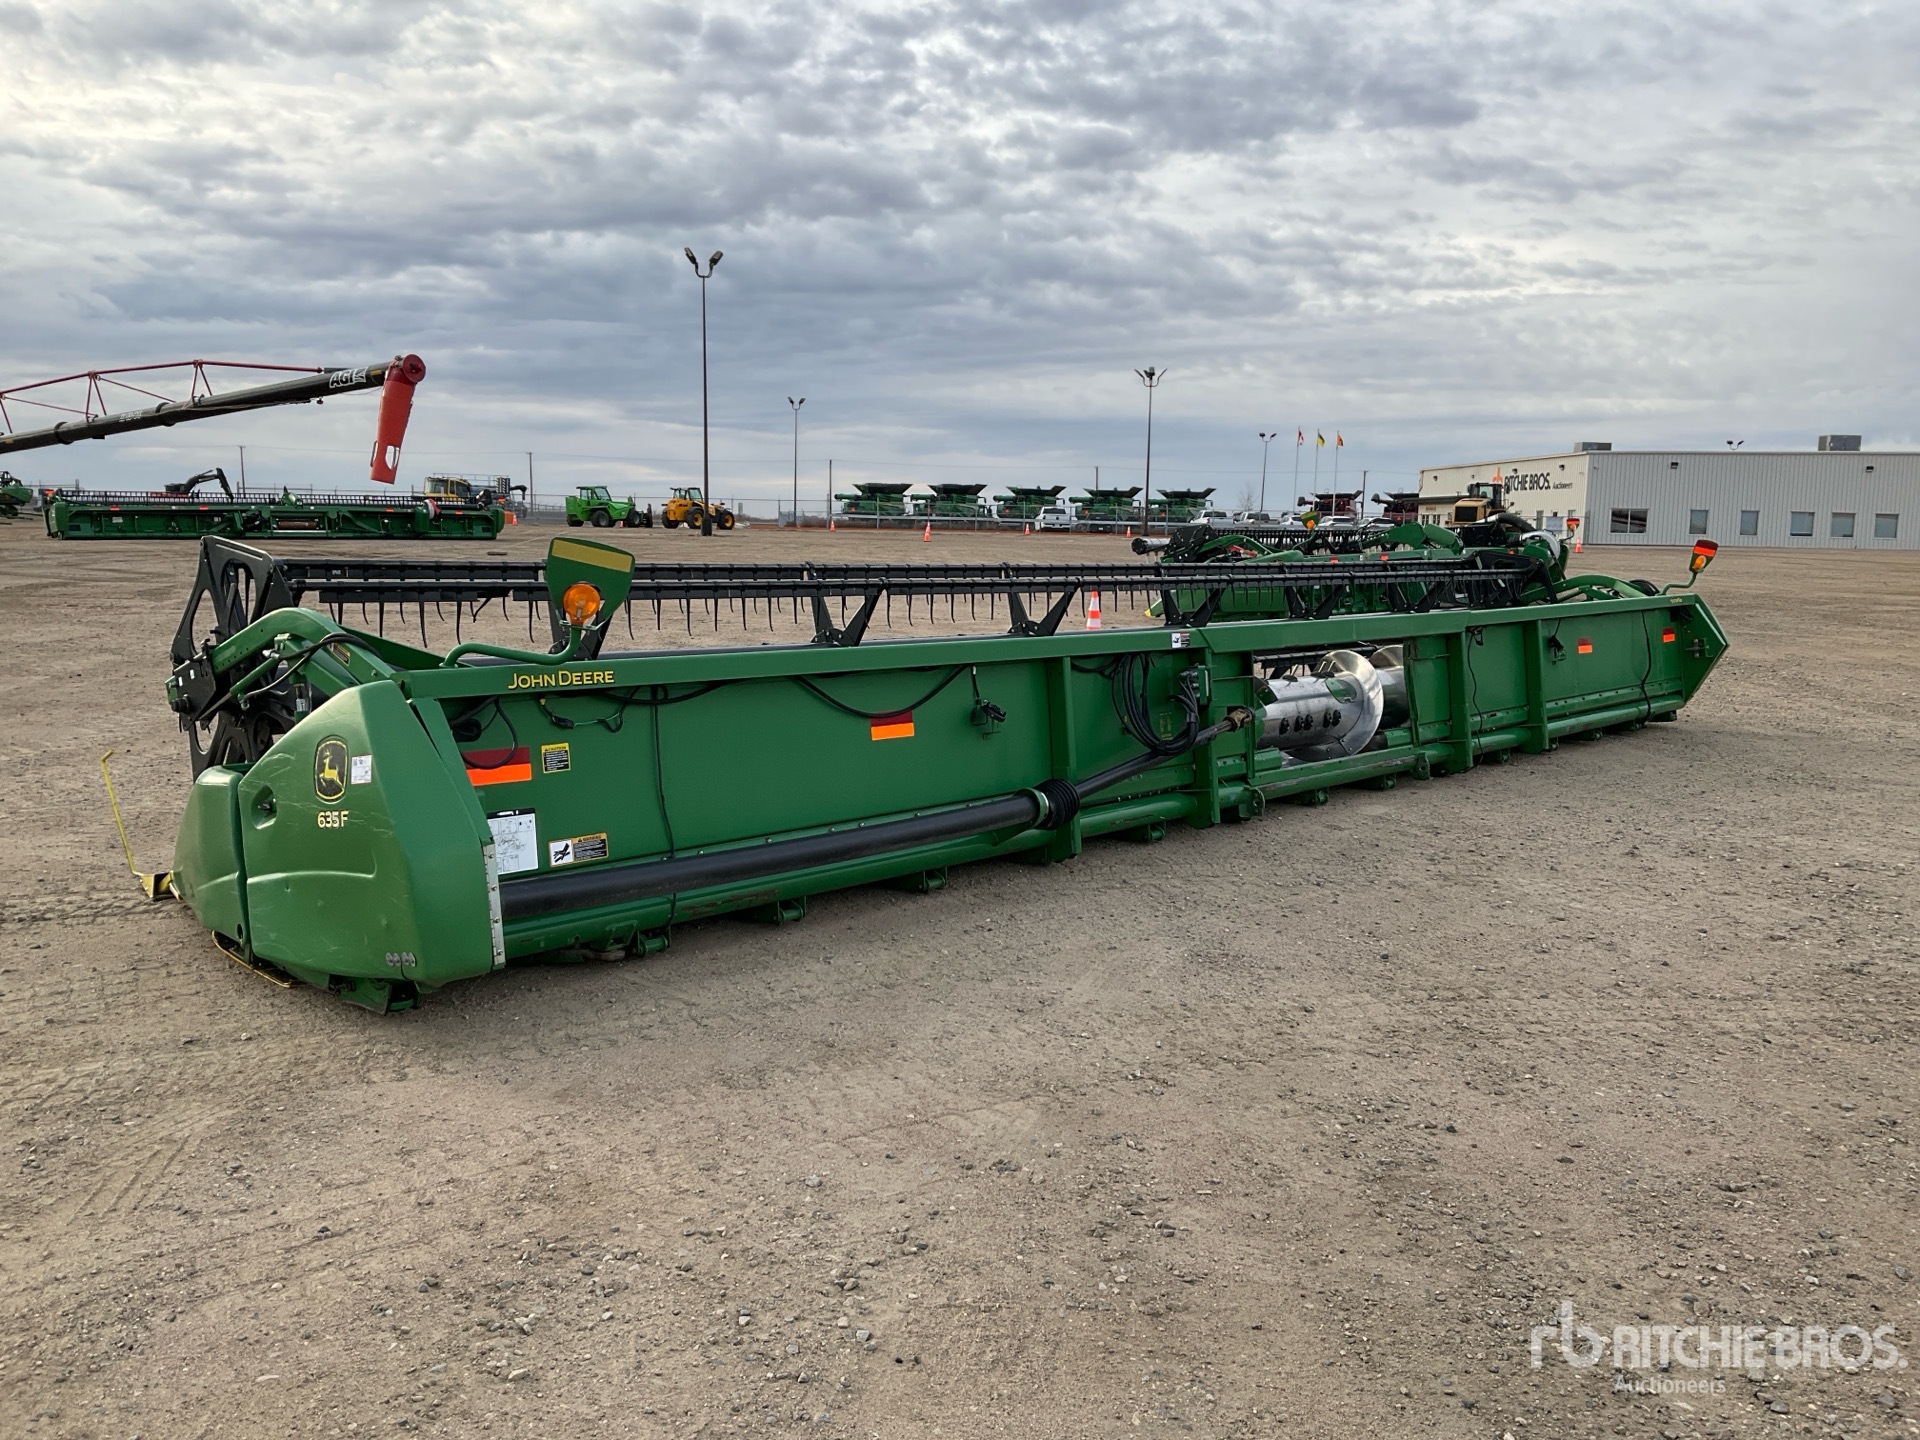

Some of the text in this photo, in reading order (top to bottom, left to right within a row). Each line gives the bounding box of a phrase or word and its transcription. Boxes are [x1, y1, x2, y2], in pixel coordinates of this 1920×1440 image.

[329, 369, 355, 389] AGI
[1504, 474, 1528, 492] RITCHIE
[1529, 472, 1551, 490] BROS.
[508, 670, 615, 689] JOHN DEERE
[317, 810, 349, 828] 635F
